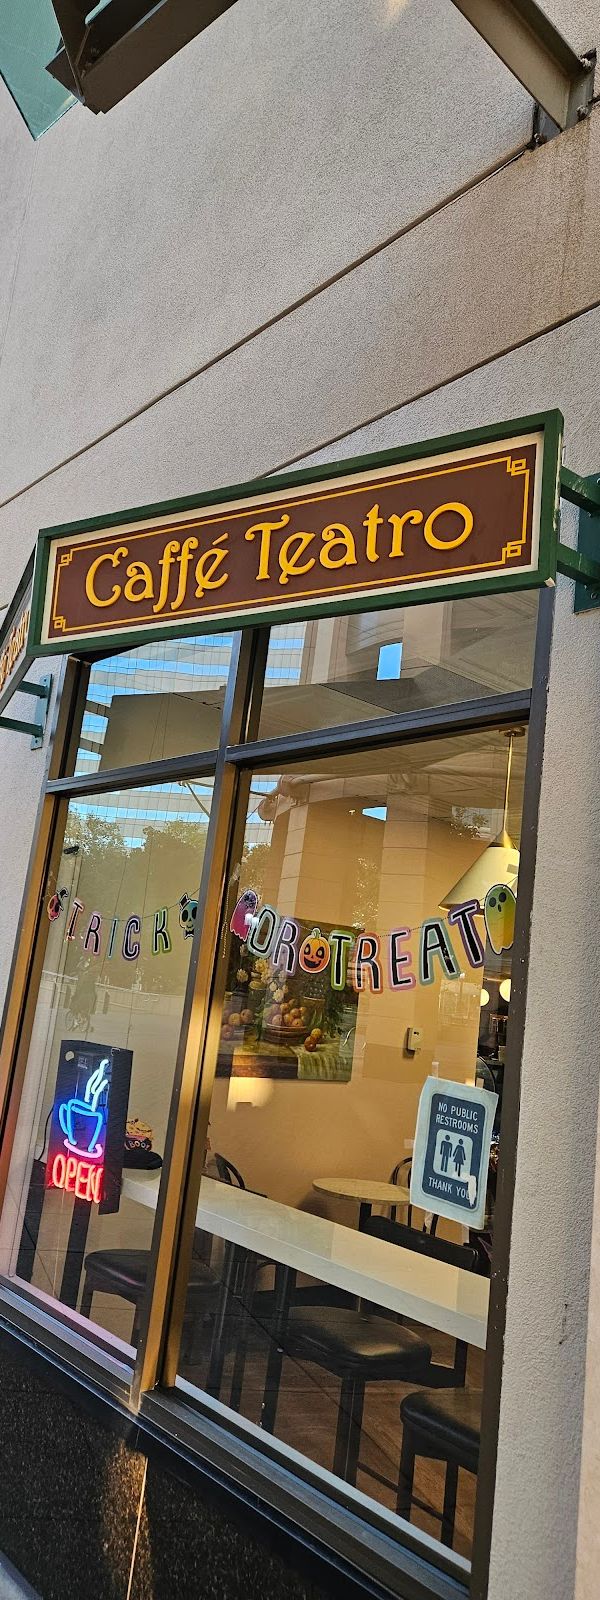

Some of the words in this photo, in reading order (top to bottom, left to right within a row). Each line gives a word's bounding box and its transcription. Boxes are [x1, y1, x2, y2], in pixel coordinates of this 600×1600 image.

[85, 532, 230, 614] Caffé
[245, 501, 474, 585] Teatro
[66, 897, 172, 962] TRICK
[247, 904, 300, 976] OR
[328, 899, 486, 995] TREAT
[435, 1113, 479, 1134] RESTROOMS
[438, 1102, 448, 1113] NO
[451, 1105, 478, 1121] PUBLIC
[52, 1153, 104, 1204] OPEN
[428, 1176, 453, 1194] THANK
